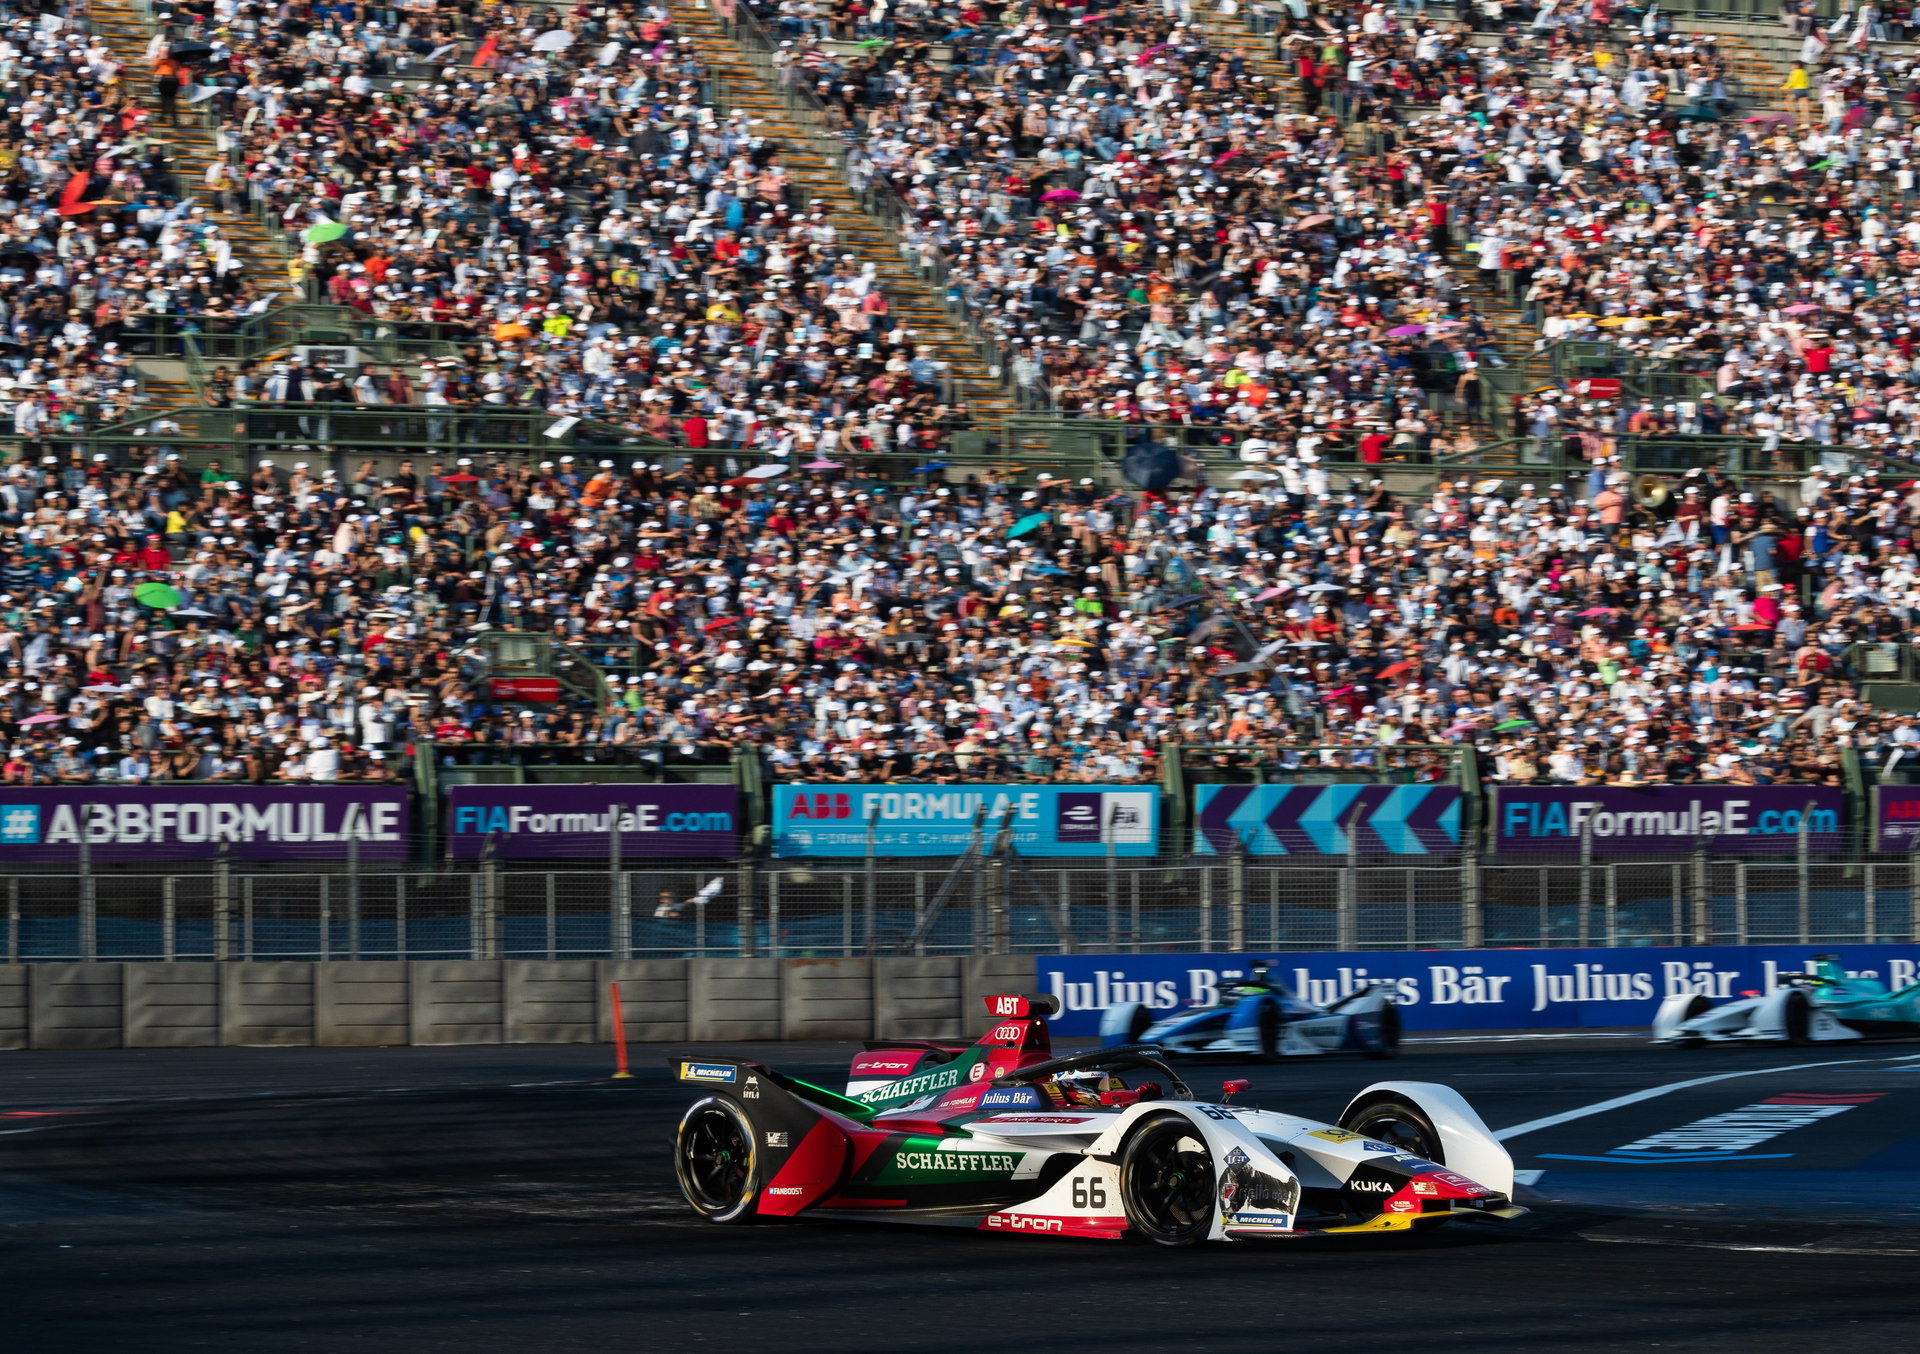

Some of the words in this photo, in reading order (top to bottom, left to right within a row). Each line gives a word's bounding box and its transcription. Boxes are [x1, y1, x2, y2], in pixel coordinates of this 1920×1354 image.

[788, 793, 853, 819] ABB
[1428, 965, 1512, 1004] Bär
[1530, 963, 1655, 1011] Julius
[1660, 961, 1741, 999] Bär
[1047, 970, 1179, 1021] Julius
[996, 997, 1019, 1015] ABT
[696, 1068, 733, 1078] MICHELIN
[860, 1069, 959, 1103] SCHAEFFLER
[981, 1092, 1010, 1106] Julius
[1011, 1092, 1033, 1104] Bär
[1195, 1105, 1238, 1121] 66
[896, 1152, 1015, 1171] SCHAEFFLER
[1072, 1176, 1107, 1209] 66
[1350, 1180, 1394, 1193] KUKA
[987, 1213, 1063, 1232] e-tron
[1240, 1216, 1283, 1224] MICHELIN
